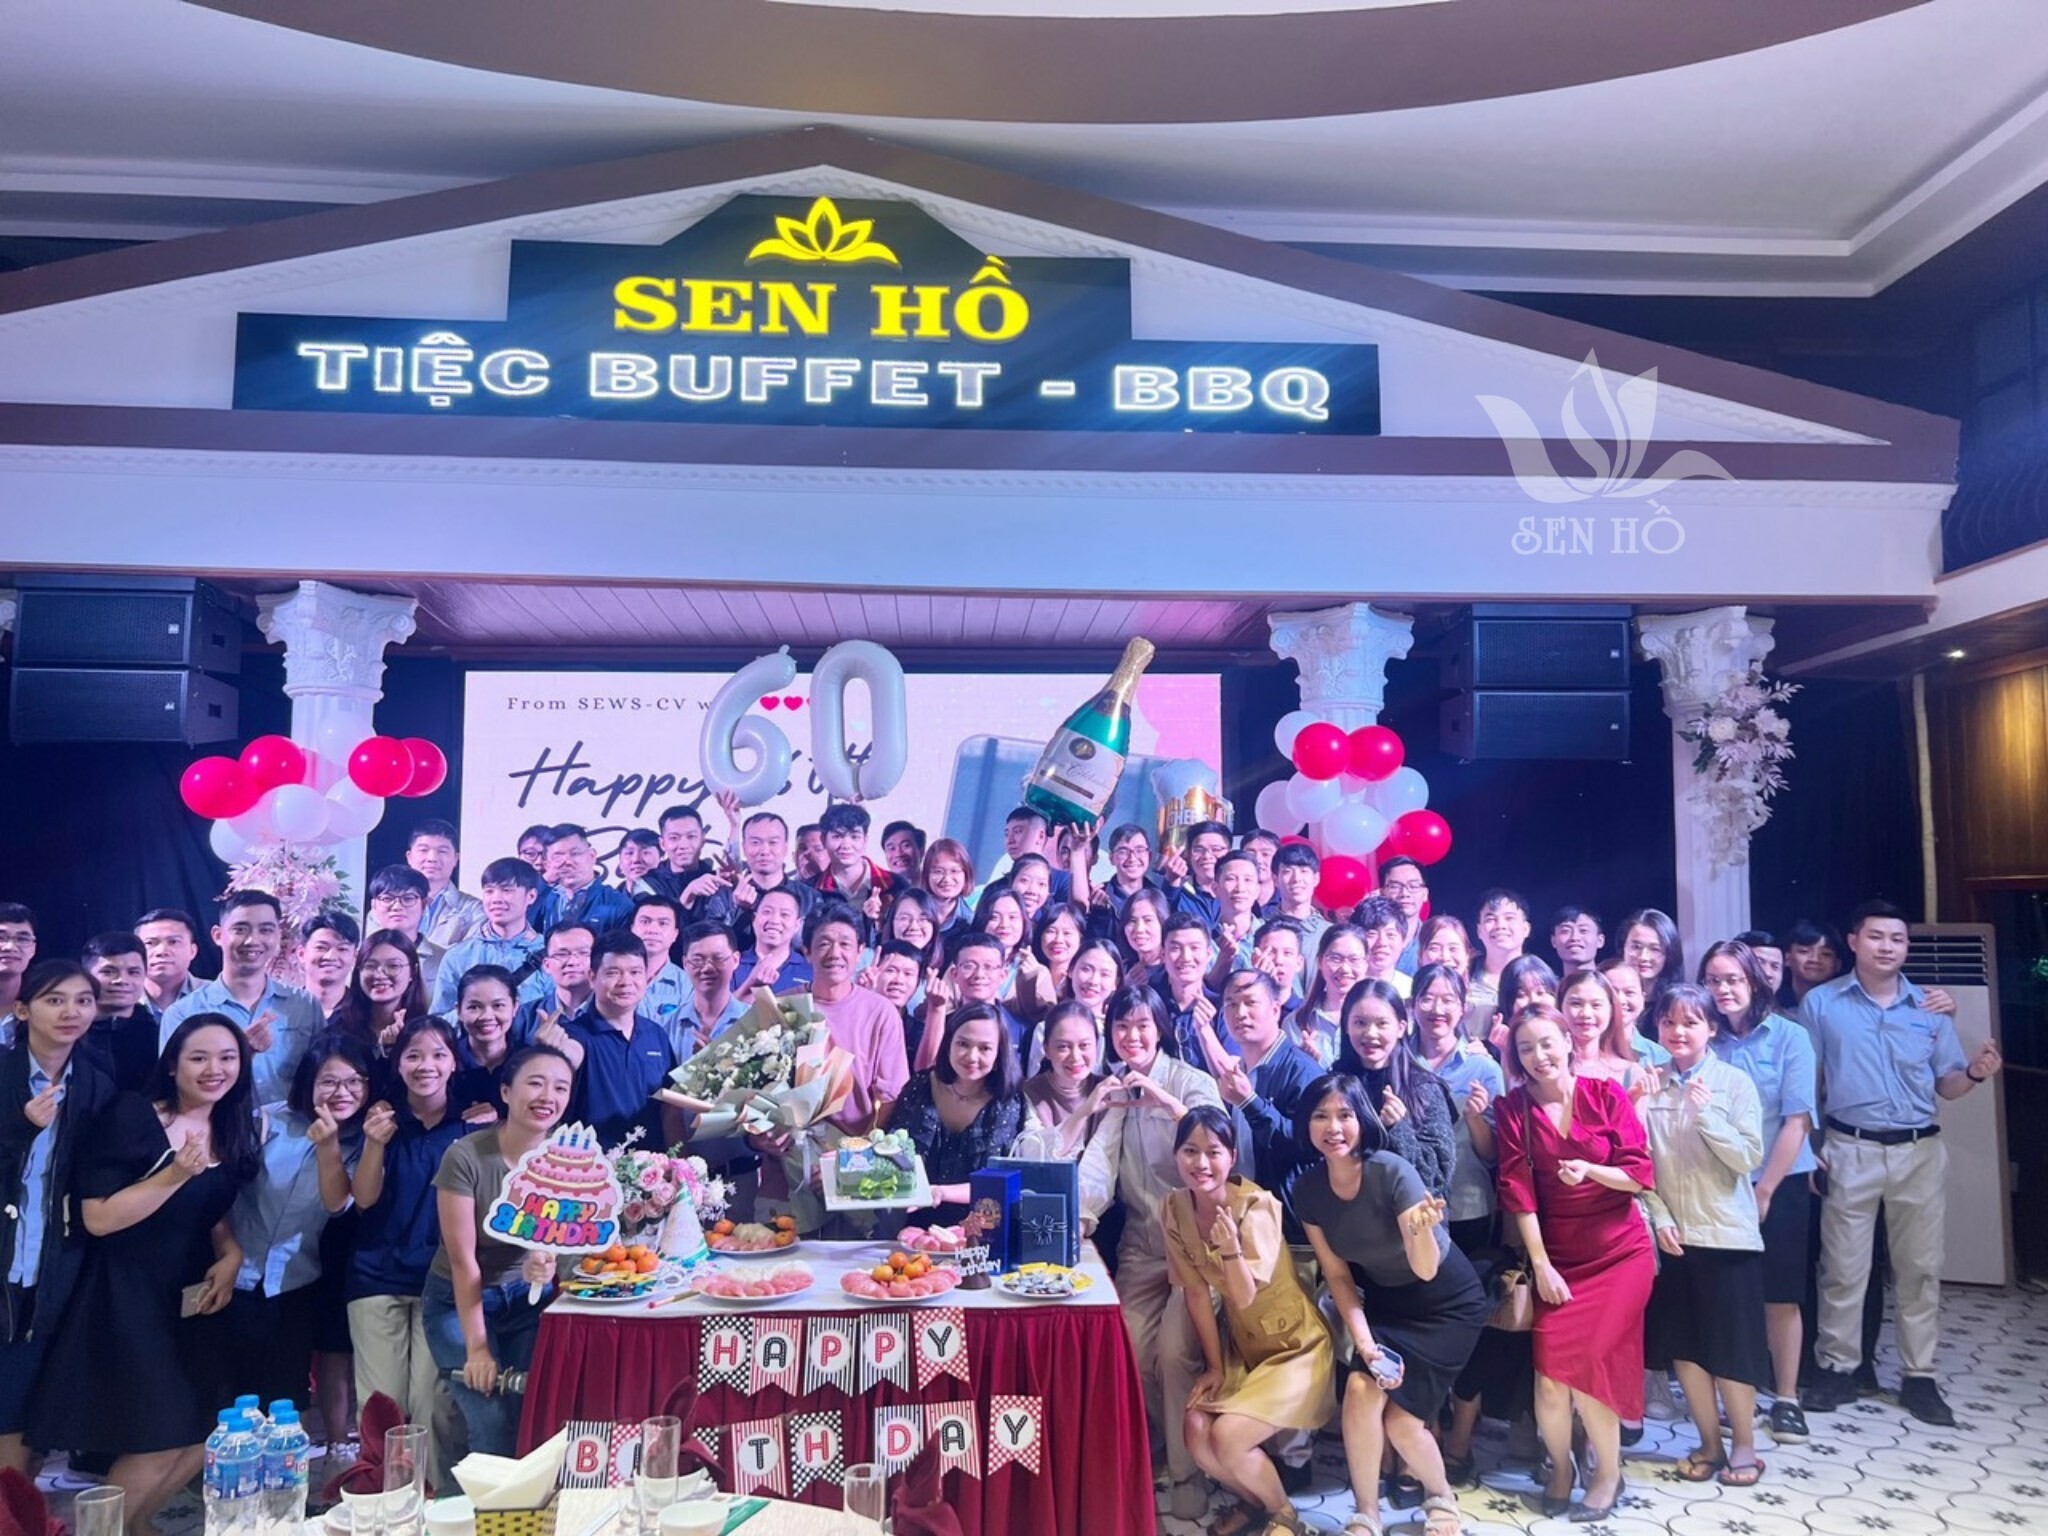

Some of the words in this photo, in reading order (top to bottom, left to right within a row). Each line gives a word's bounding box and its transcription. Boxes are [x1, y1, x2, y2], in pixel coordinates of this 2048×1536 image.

[613, 275, 836, 335] SEN
[869, 255, 1030, 341] HỒ
[298, 332, 550, 406] TIỆC
[589, 352, 1001, 408] BUFFET
[1113, 365, 1331, 420] BBQ
[507, 696, 567, 710] From
[577, 696, 687, 711] SEWS-CV
[508, 740, 713, 818] Happy
[489, 1202, 615, 1247] BIRTHDAY
[523, 1192, 598, 1224] HAPPY
[713, 1324, 953, 1369] HAPPY
